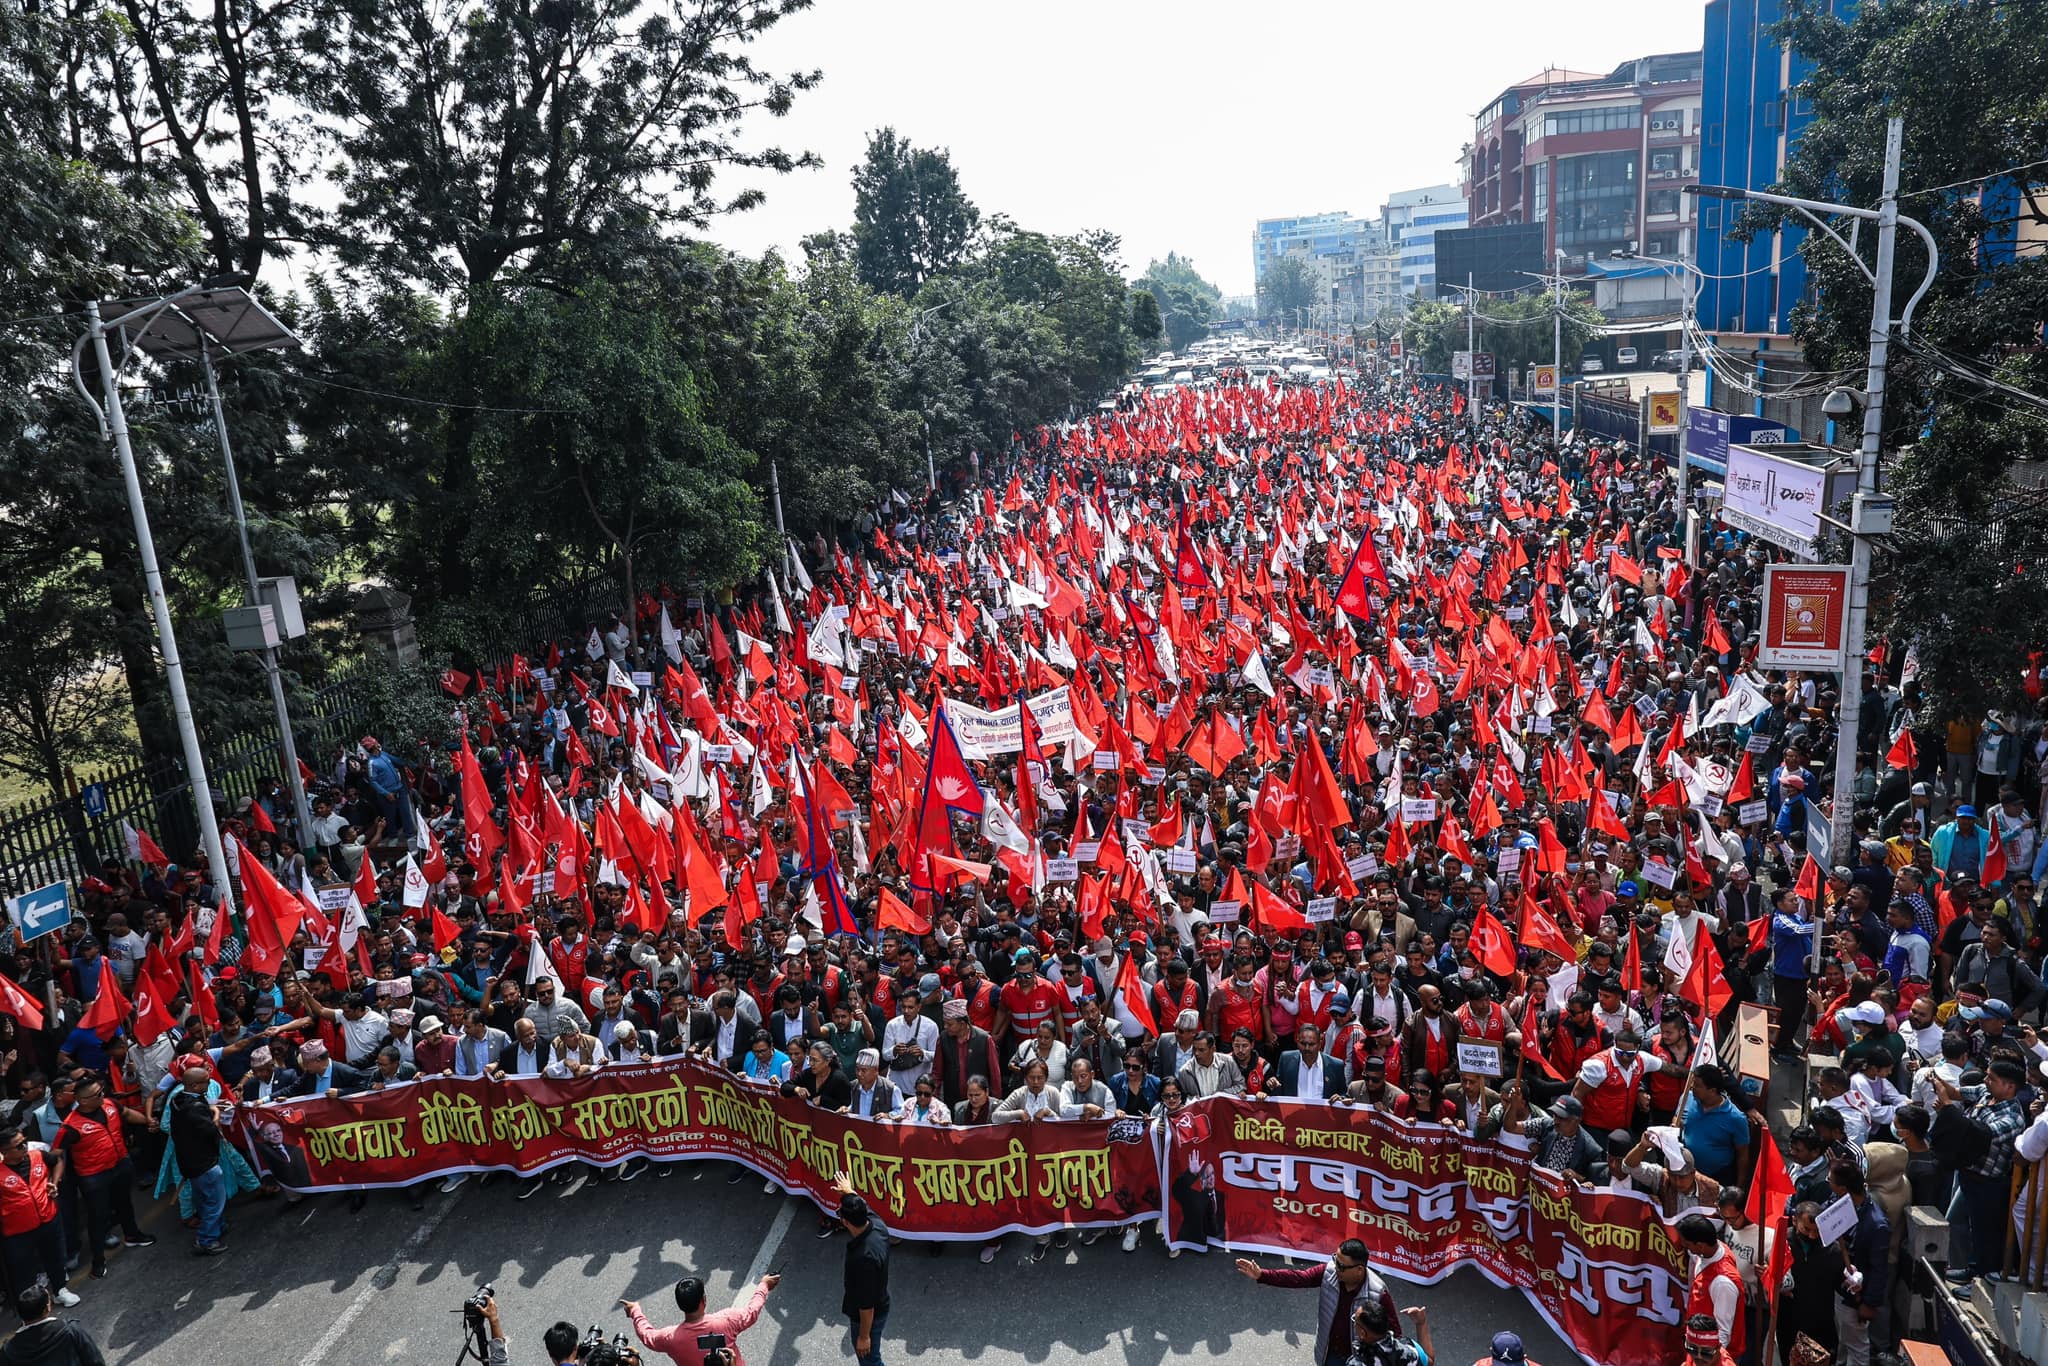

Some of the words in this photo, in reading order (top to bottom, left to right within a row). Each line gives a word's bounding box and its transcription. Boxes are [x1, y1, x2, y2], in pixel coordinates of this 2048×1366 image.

[305, 1117, 415, 1167] भ्रष्टाचार,
[571, 1074, 689, 1141] सरकारको
[911, 1138, 1028, 1207] खबरदारी
[1035, 1146, 1111, 1209] जुलुस
[602, 1133, 642, 1150] २०८१
[647, 1131, 705, 1145] कार्तिक
[709, 1132, 728, 1142] १०
[1430, 1154, 1441, 1175] र
[1273, 1197, 1339, 1219] २०८१
[1552, 1228, 1690, 1327] जुलु
